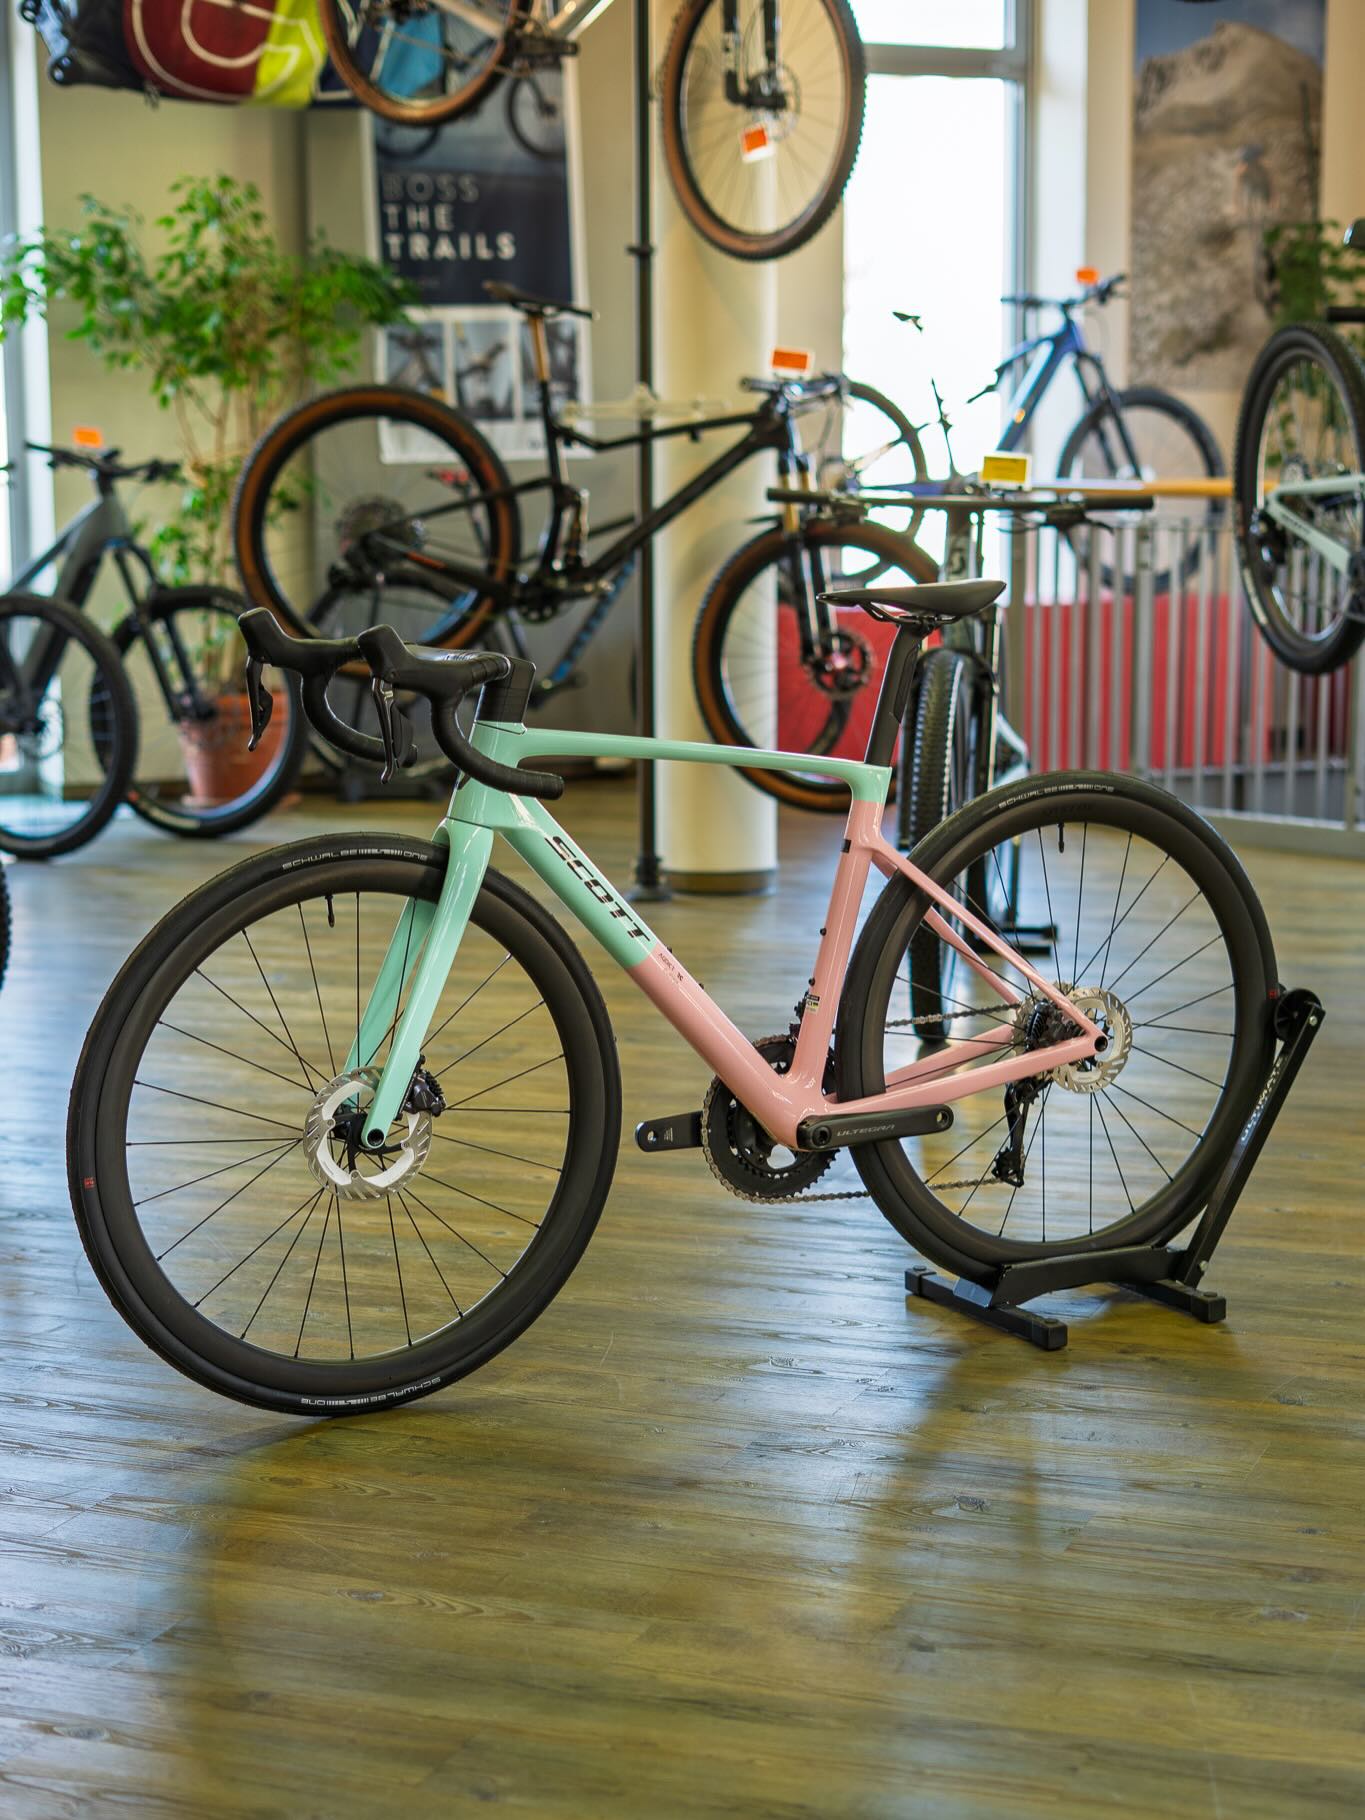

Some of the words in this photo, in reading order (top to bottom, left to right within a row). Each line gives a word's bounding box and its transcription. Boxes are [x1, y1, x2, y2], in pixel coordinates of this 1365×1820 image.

[384, 203, 453, 230] THE
[384, 232, 516, 260] TRAILS
[999, 787, 1057, 808] SCHWALBE
[282, 850, 357, 870] SCHWALBE
[403, 851, 428, 861] ONE
[545, 836, 650, 941] SCOTT
[837, 1124, 895, 1137] ULTEGRA
[370, 1377, 441, 1401] SCHWALBE
[301, 1397, 325, 1405] ONE
